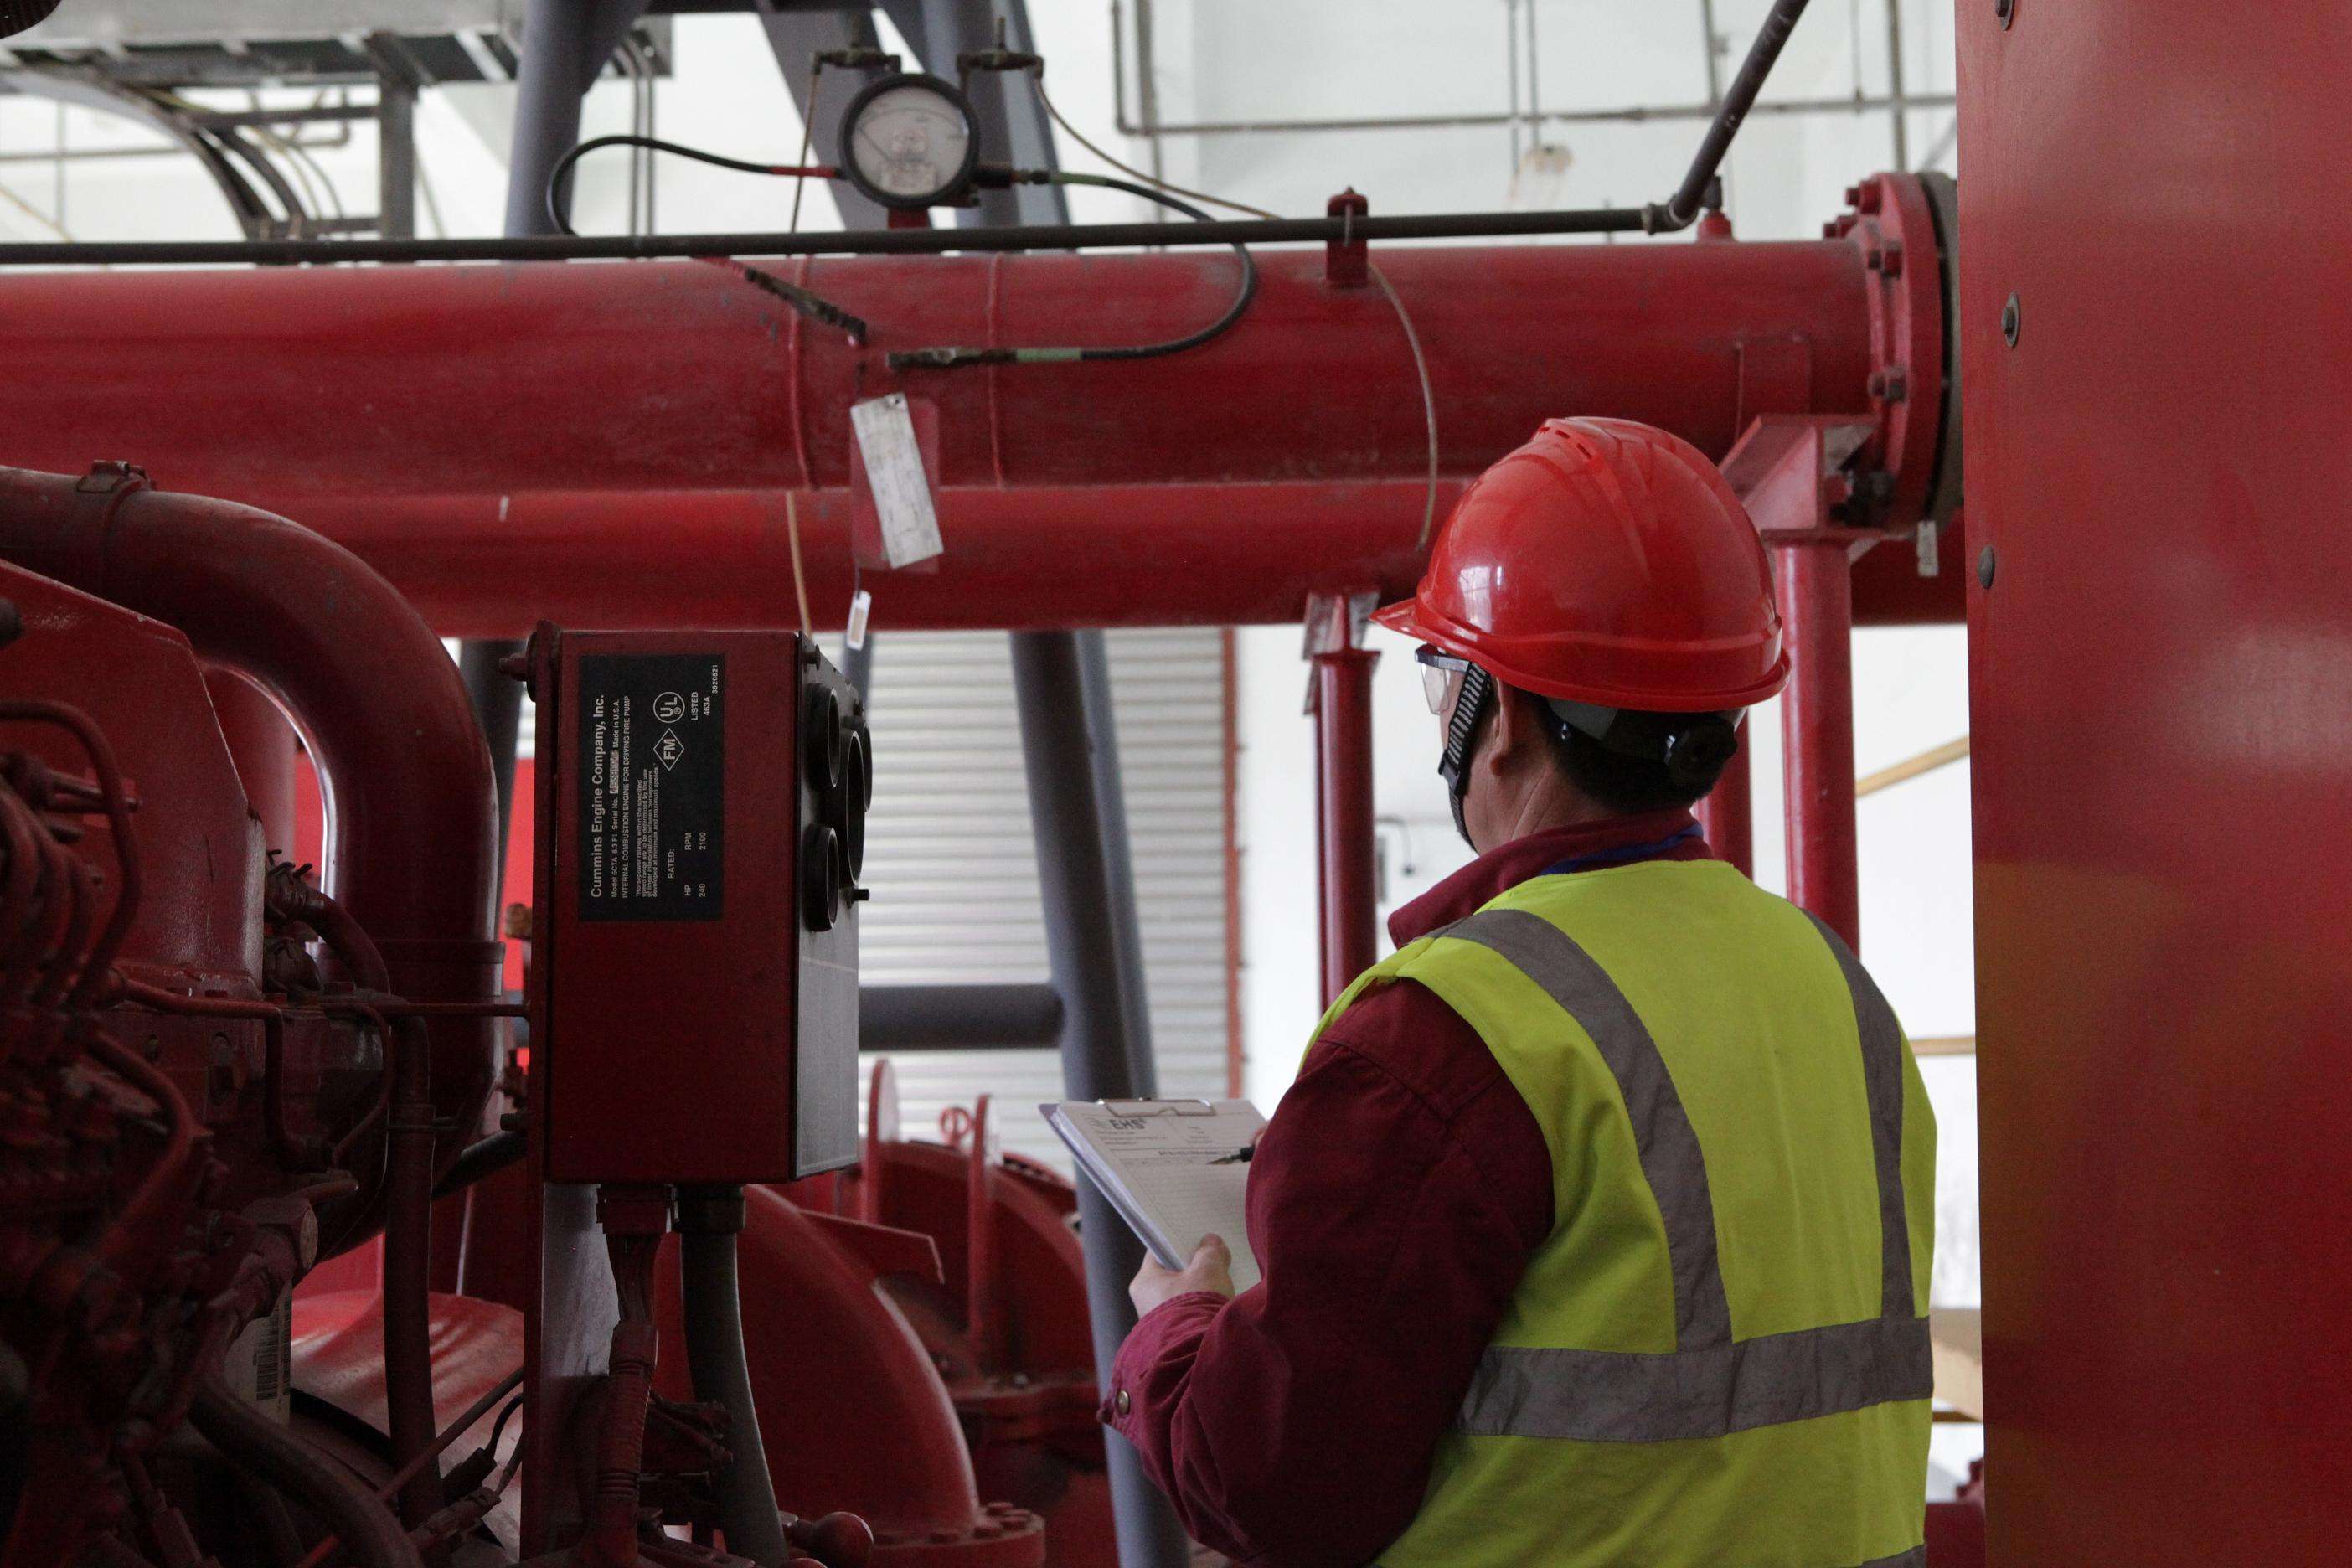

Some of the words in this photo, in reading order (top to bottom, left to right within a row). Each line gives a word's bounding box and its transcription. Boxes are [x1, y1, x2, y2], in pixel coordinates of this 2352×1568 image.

[593, 694, 604, 717] Inc.
[660, 697, 677, 717] UL
[592, 721, 606, 784] Company,
[663, 739, 675, 760] FM
[591, 788, 606, 833] Engine
[591, 837, 602, 897] Cummins
[684, 885, 691, 896] HP
